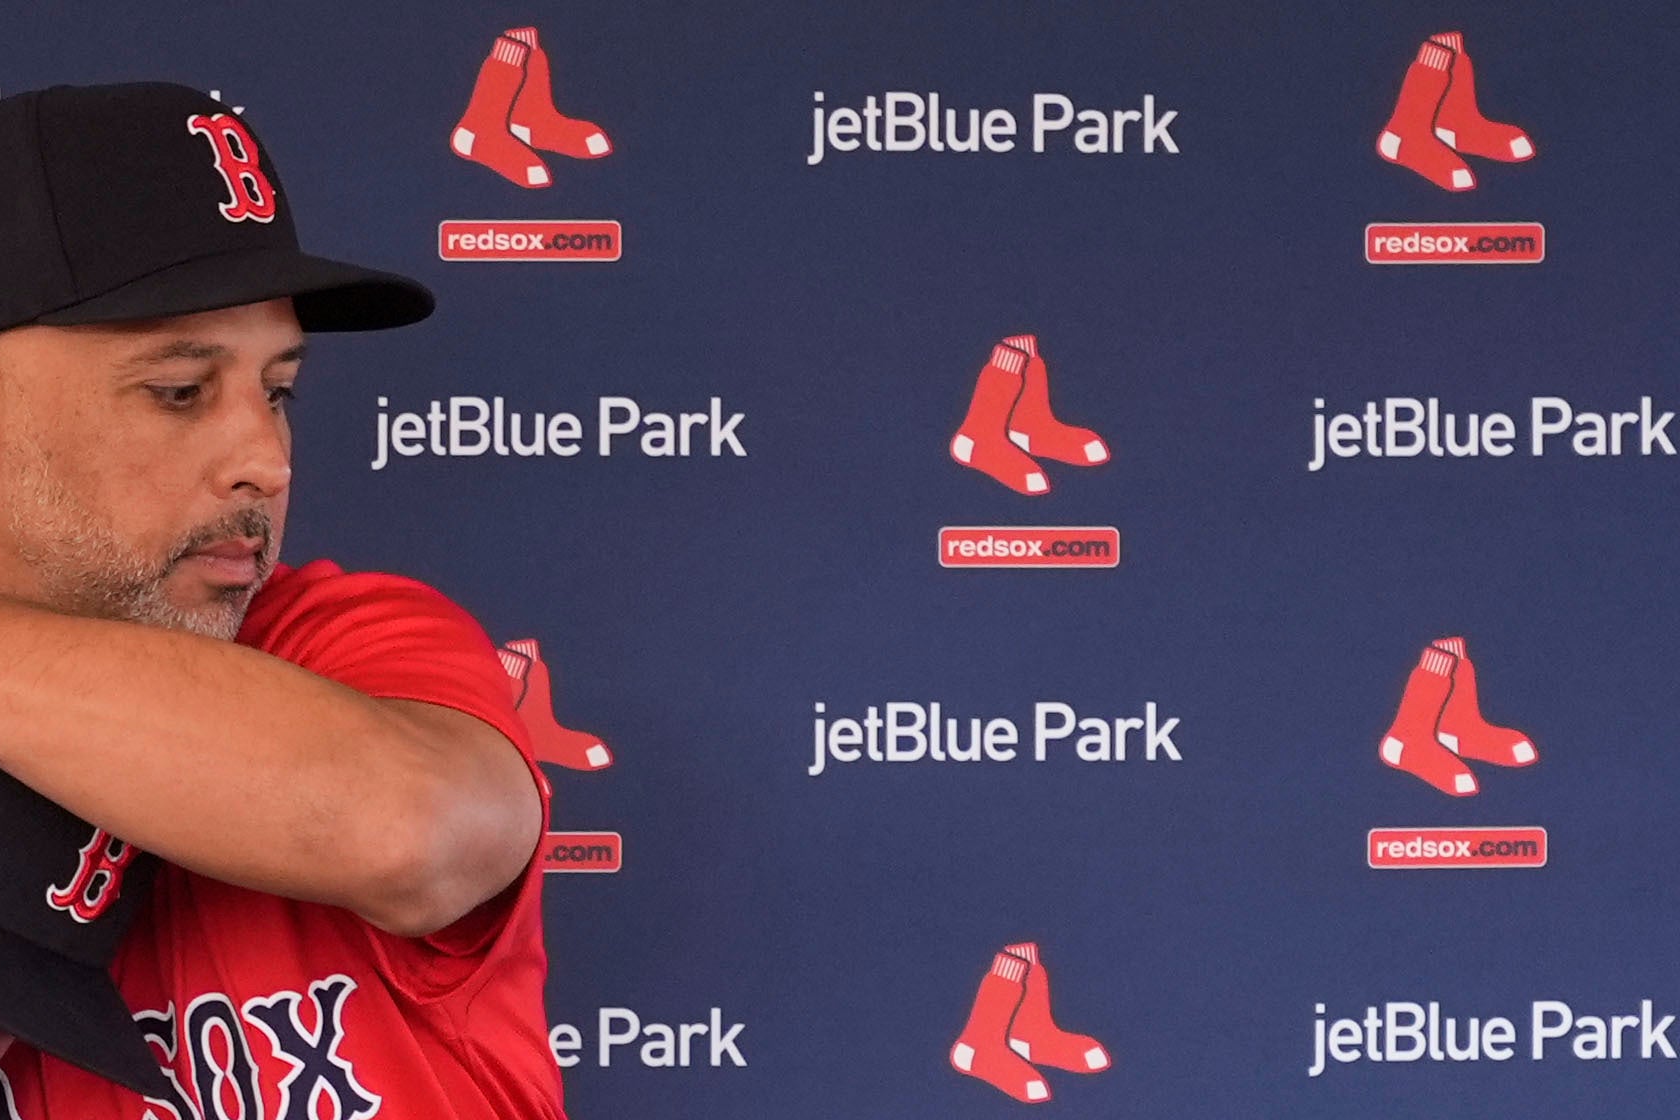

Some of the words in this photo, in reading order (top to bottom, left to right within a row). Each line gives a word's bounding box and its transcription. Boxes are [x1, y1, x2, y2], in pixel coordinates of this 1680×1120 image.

[808, 92, 1016, 165] jetBlue
[1034, 94, 1179, 153] Park
[187, 113, 276, 223] B
[449, 230, 612, 251] redsox.com
[1375, 233, 1536, 253] redsox.com
[372, 397, 582, 469] jetBlue
[600, 397, 746, 456] Park
[1309, 398, 1515, 471] jetBlue
[1532, 396, 1676, 456] Park
[949, 536, 1110, 557] redsox.com
[808, 702, 1018, 775] jetBlue
[1035, 702, 1182, 761] Park
[46, 826, 141, 924] B
[1377, 837, 1538, 858] redsox.com
[599, 1007, 748, 1067] Park
[1309, 1002, 1515, 1076] jetBlue
[1532, 1000, 1677, 1059] Park
